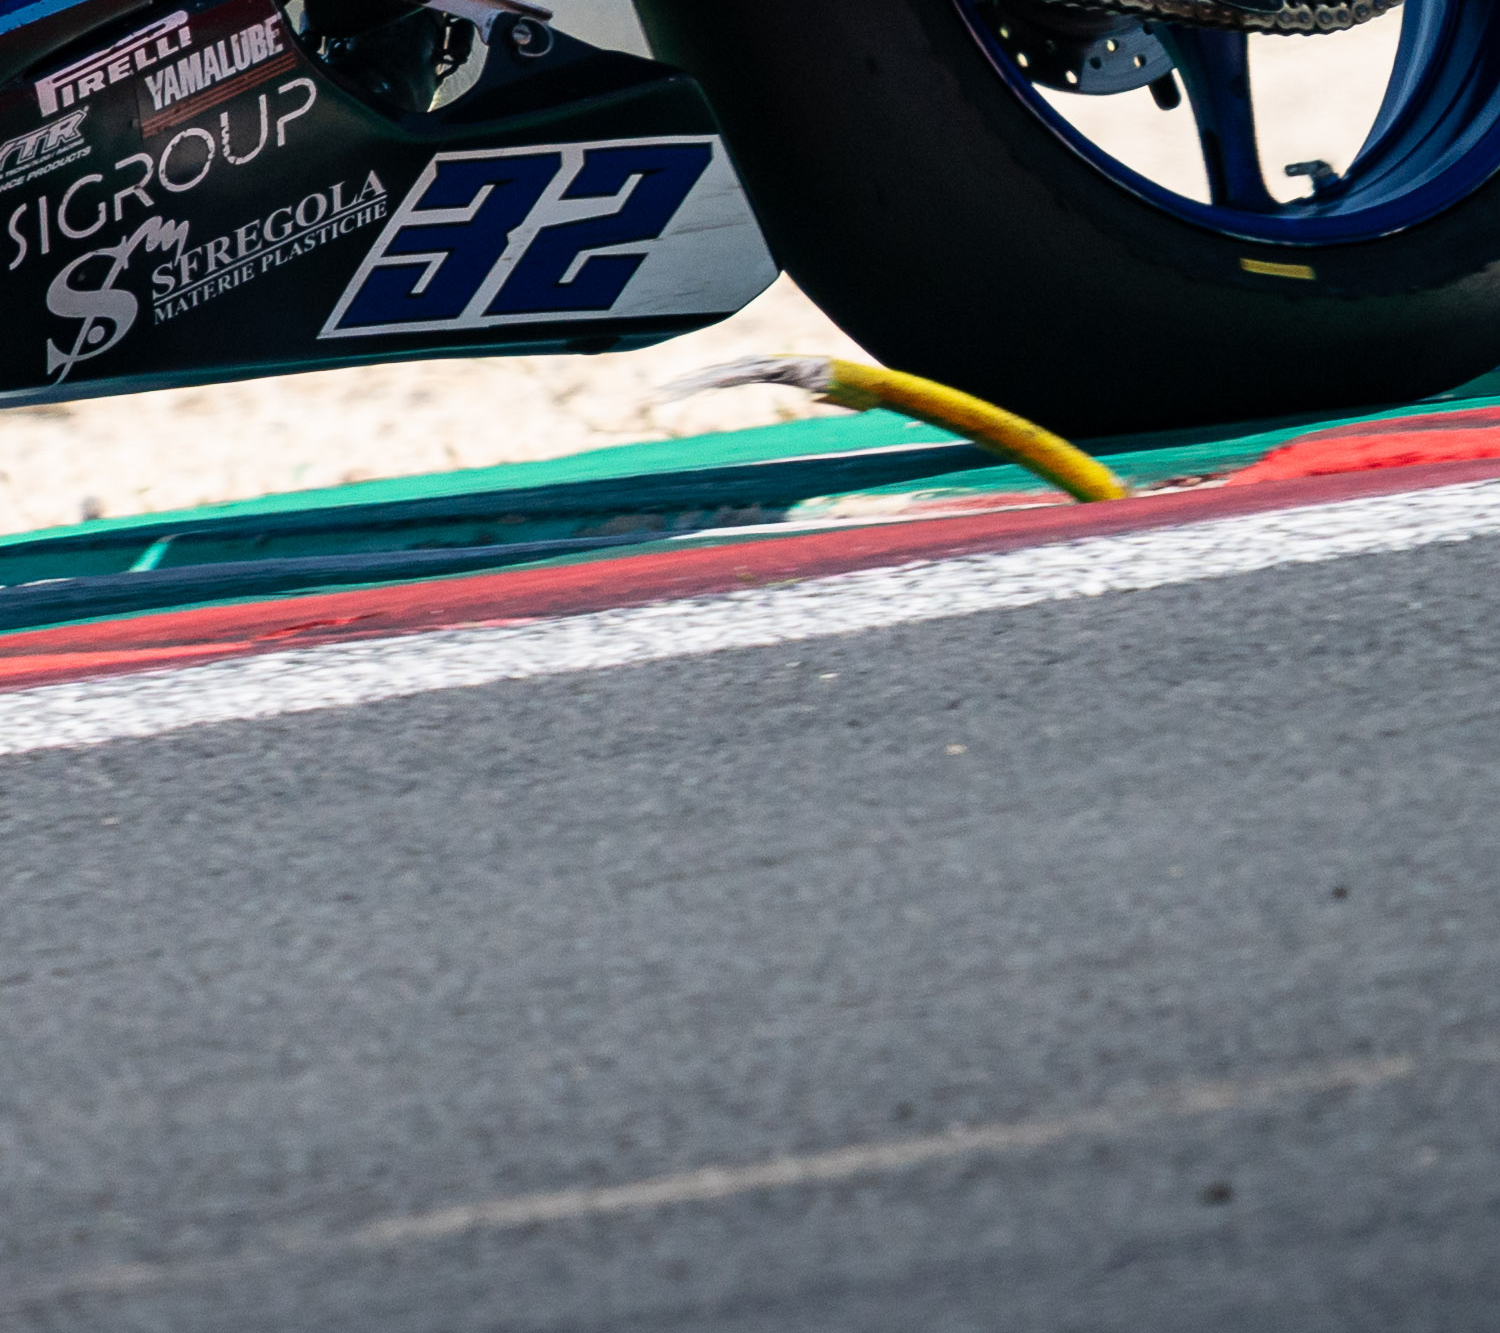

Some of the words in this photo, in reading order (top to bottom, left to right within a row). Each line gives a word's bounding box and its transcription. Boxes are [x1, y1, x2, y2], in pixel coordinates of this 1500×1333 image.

[35, 10, 192, 118] PIRELLI
[144, 12, 284, 112] YAMALUBE
[26, 145, 93, 182] PRODUCTS
[152, 169, 389, 301] SFREGOLA
[153, 262, 257, 326] MATERIE
[261, 200, 389, 276] PLASTICHE
[332, 142, 714, 331] 32
